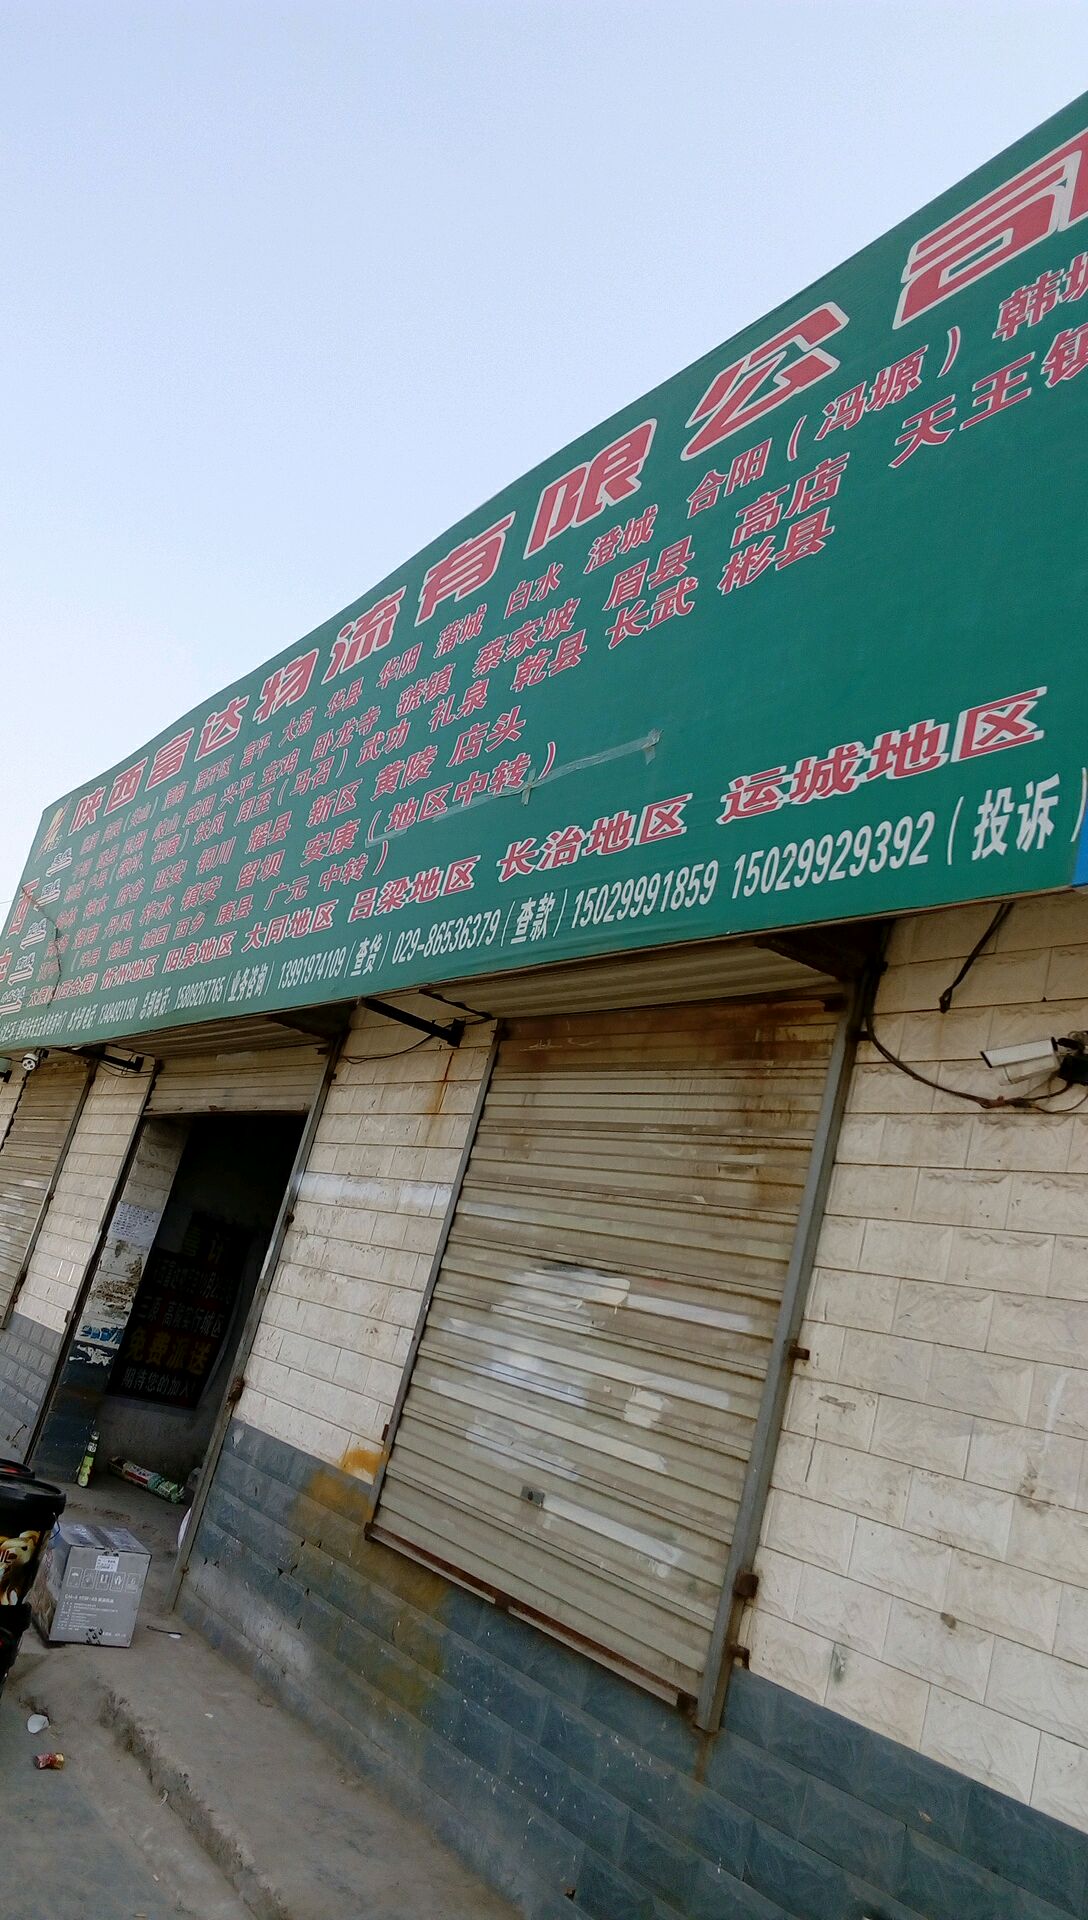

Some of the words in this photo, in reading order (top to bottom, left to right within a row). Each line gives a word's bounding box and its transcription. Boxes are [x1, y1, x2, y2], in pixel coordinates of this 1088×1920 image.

[68, 127, 1088, 836] 陕西富达物流有限公司
[182, 793, 217, 828] 咸阳
[218, 772, 256, 810] 兴平
[258, 748, 300, 790] 宝鸡
[310, 705, 381, 762] 卧龙寺
[395, 663, 456, 717] 虢镇
[471, 597, 580, 680] 蔡家坡
[602, 535, 695, 611] 眉县
[730, 452, 850, 549] 高店
[193, 811, 227, 846] 扶风
[355, 718, 411, 767] 武功
[430, 678, 490, 733] 礼泉
[510, 629, 588, 692] 乾县
[605, 577, 698, 650] 长武
[717, 507, 835, 595] 彬县
[240, 731, 273, 769] 富平
[278, 706, 317, 748] 大荔
[324, 677, 363, 719] 华县
[376, 642, 423, 689] 华阴
[434, 603, 487, 659] 蒲城
[504, 562, 563, 619] 白水
[583, 504, 658, 574] 澄城
[100, 955, 160, 990] 忻州地区
[162, 931, 237, 973] 阳泉地区
[241, 899, 339, 953] 大同地区
[347, 855, 481, 923] 吕梁地区
[496, 792, 693, 883] 长治地区
[716, 686, 1047, 824] 运城地区
[101, 909, 135, 940] 丹凤
[138, 894, 175, 927] 柞水
[180, 875, 223, 912] 镇安
[236, 850, 286, 891] 留坝
[151, 860, 188, 894] 延安
[196, 836, 236, 875] 铜川
[245, 811, 292, 854] 耀县
[305, 778, 363, 828] 新区
[370, 745, 438, 802] 黄陵
[446, 705, 528, 768] 店头
[173, 912, 206, 941] 西乡
[214, 894, 253, 926] 康县
[264, 875, 310, 911] 广元
[572, 860, 719, 928] 15029991859
[125, 1326, 212, 1376] 免费派送
